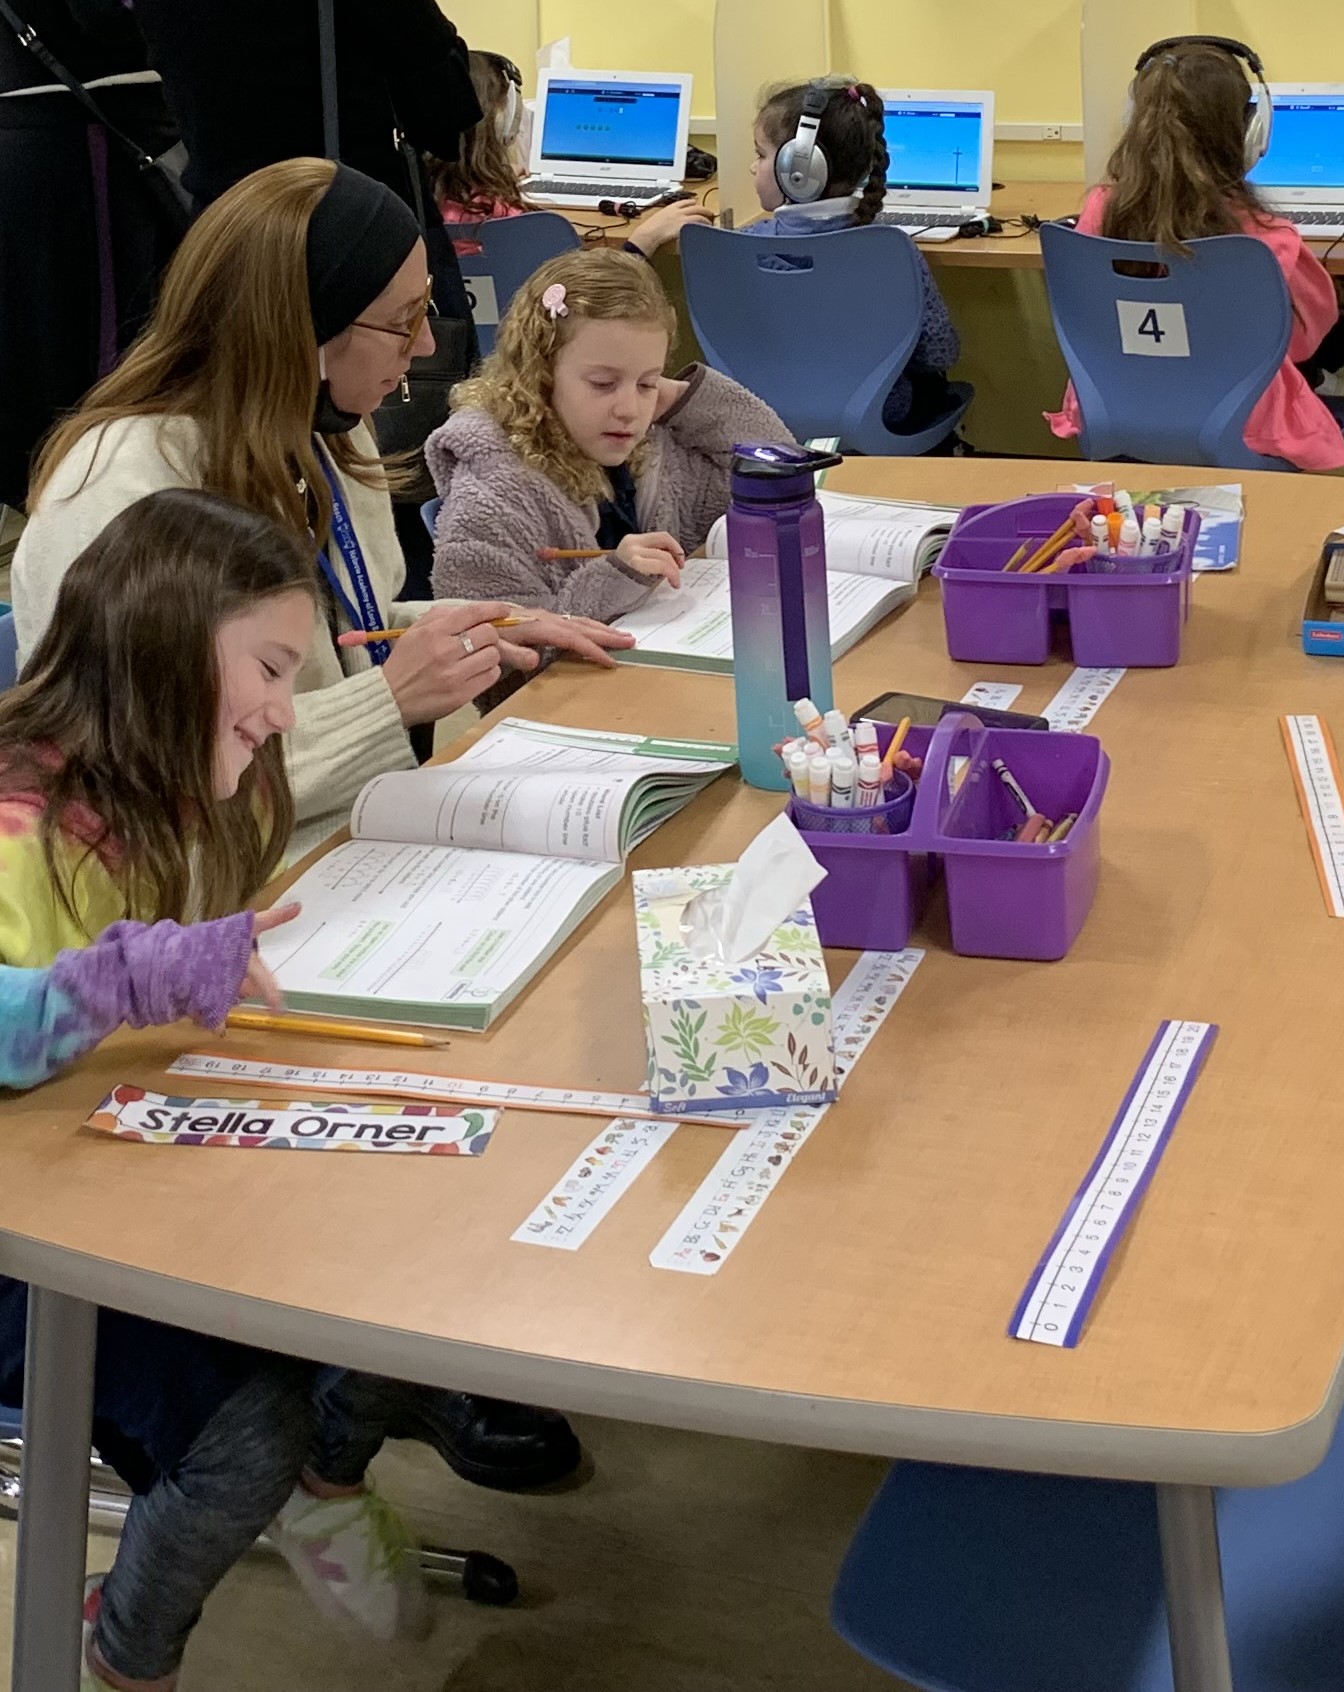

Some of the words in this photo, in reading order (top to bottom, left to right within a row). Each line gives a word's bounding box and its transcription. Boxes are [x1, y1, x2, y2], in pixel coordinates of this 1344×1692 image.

[1138, 308, 1165, 343] 4
[348, 549, 361, 575] Hebrew
[356, 574, 370, 603] Academy
[366, 611, 377, 627] Long
[1169, 1061, 1183, 1069] 17
[1163, 1075, 1177, 1085] 16
[786, 1092, 826, 1103] Elegant
[1157, 1089, 1171, 1100] 15
[663, 1101, 687, 1113] Soft
[1150, 1104, 1163, 1114] 14
[138, 1108, 274, 1136] Stella
[289, 1116, 446, 1142] Orner
[1143, 1118, 1158, 1128] 13
[1137, 1131, 1151, 1143] 12
[1130, 1149, 1144, 1157] 11
[1123, 1161, 1137, 1171] 10
[1100, 1204, 1114, 1212] 7
[1093, 1219, 1108, 1227] 6
[1085, 1233, 1100, 1242] 5
[1078, 1248, 1091, 1256] 4
[1069, 1265, 1084, 1274] 3
[1061, 1283, 1076, 1293] 2
[1044, 1322, 1058, 1332] 0
